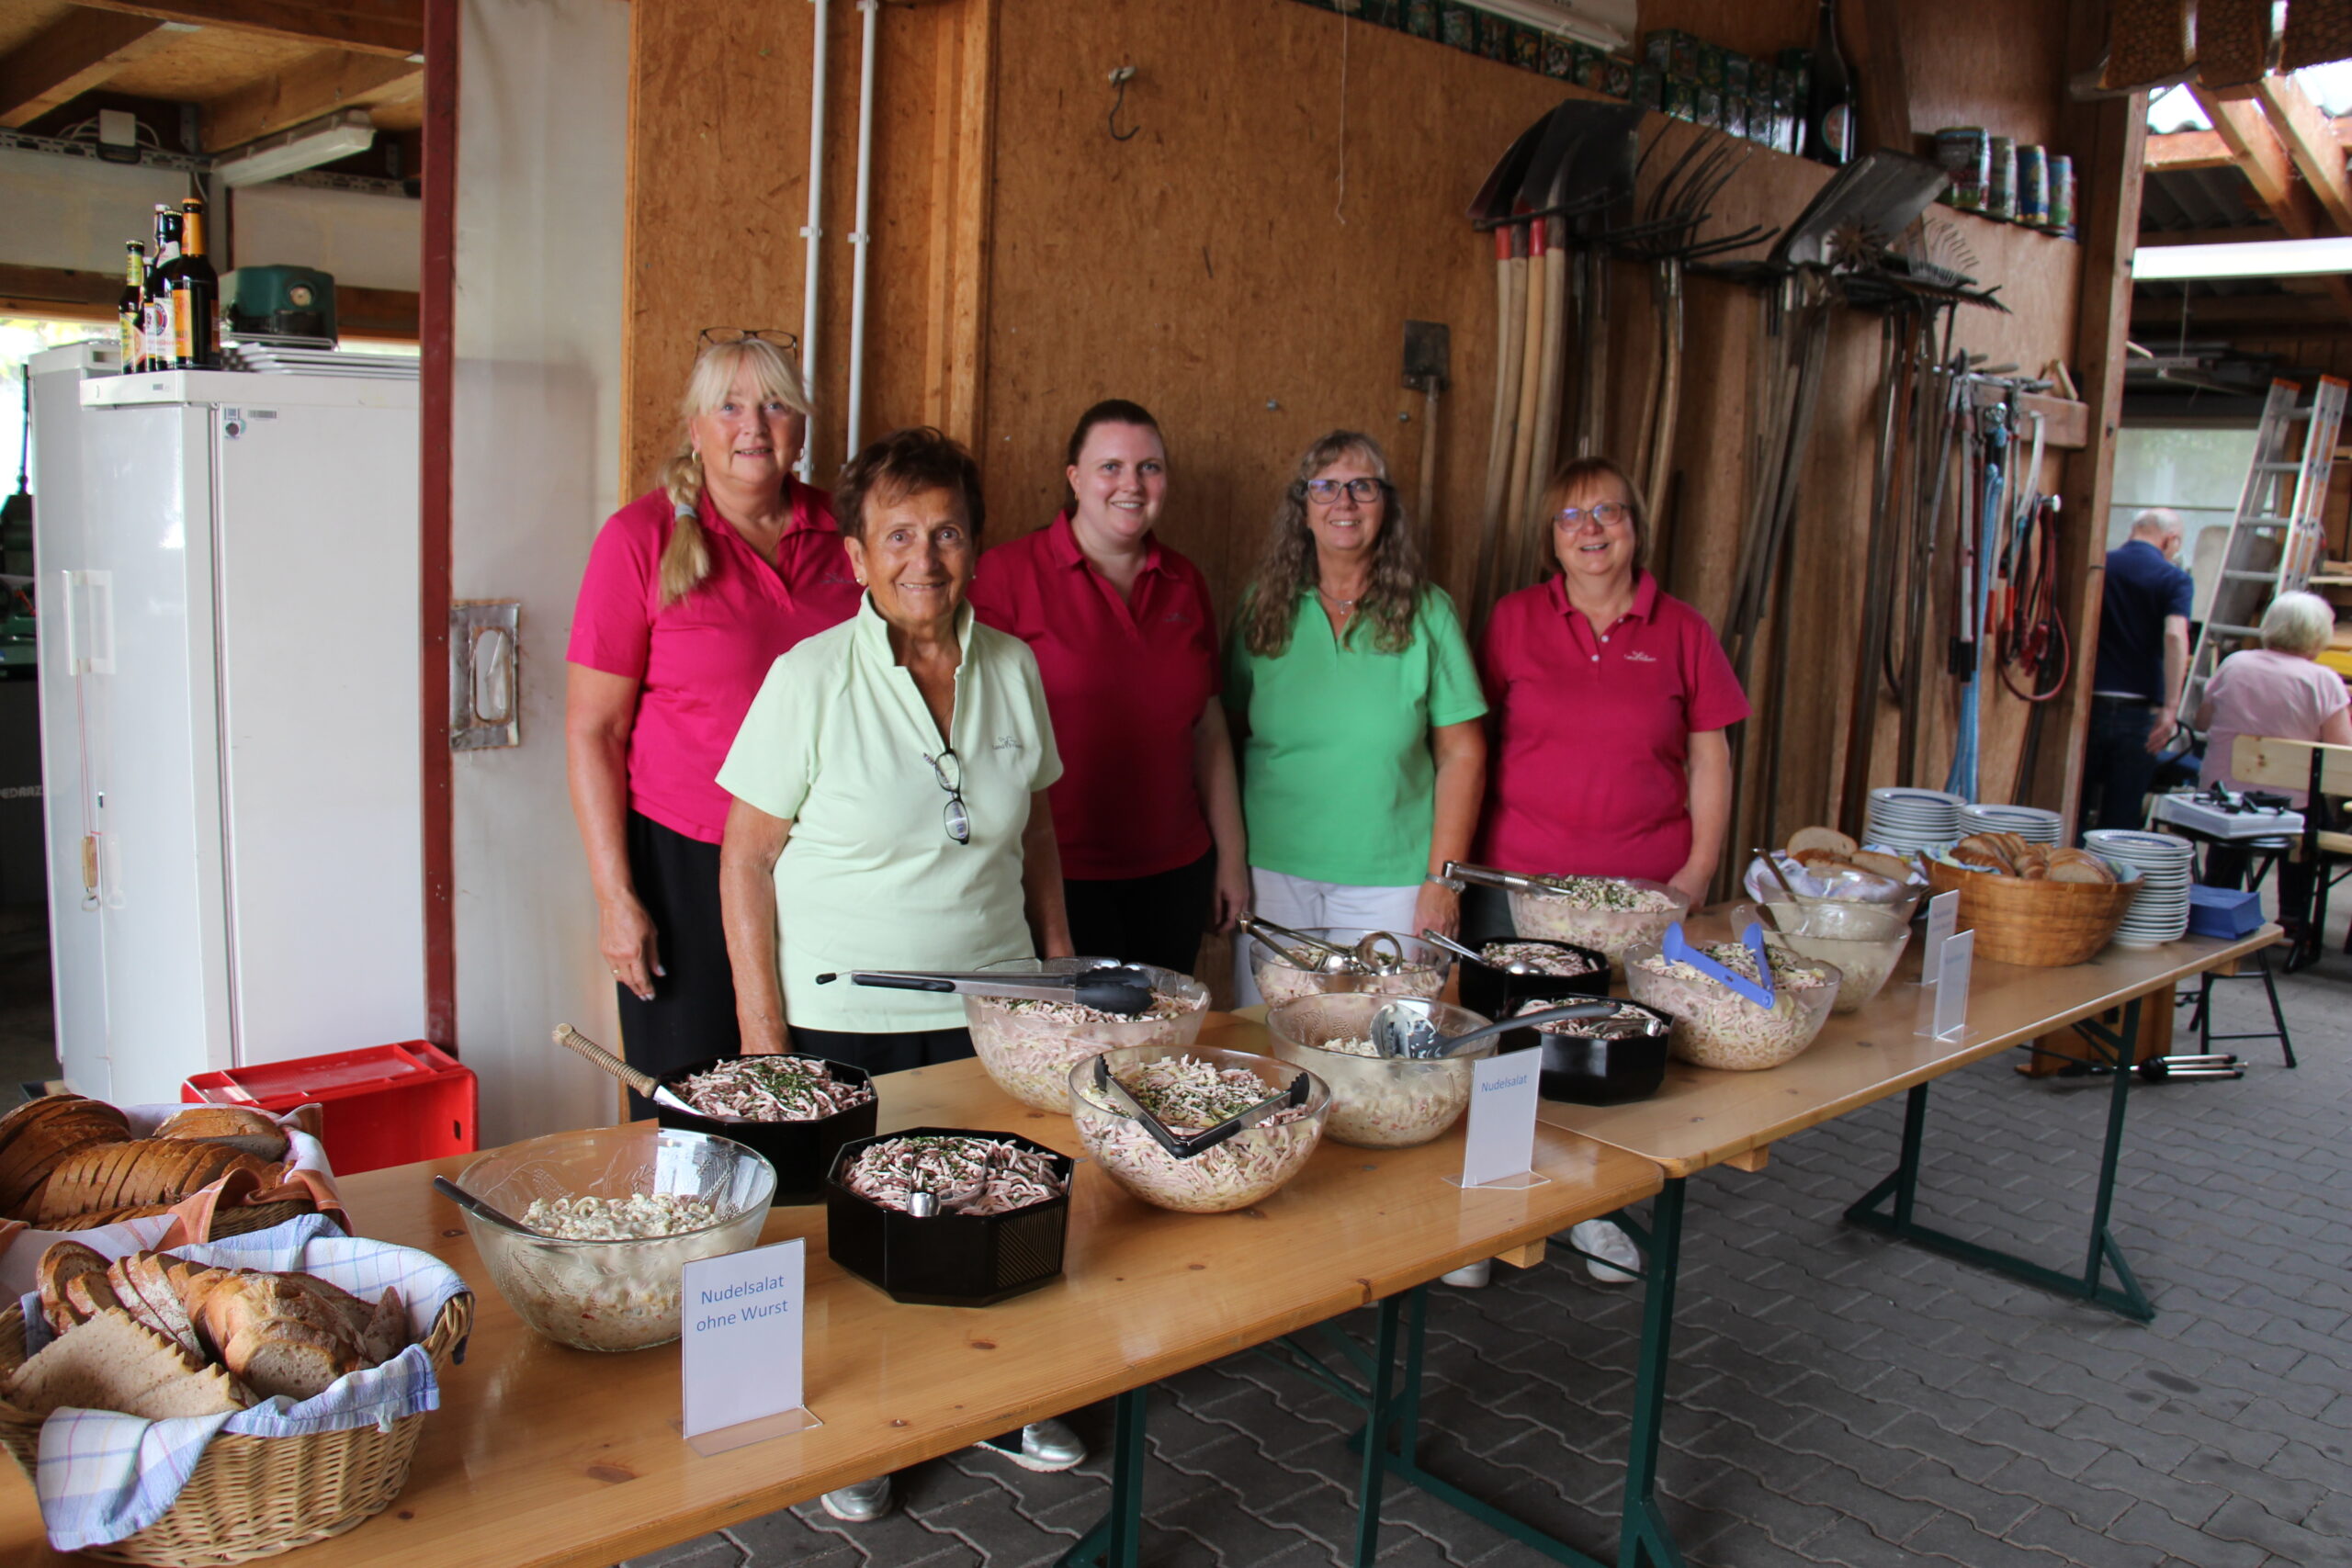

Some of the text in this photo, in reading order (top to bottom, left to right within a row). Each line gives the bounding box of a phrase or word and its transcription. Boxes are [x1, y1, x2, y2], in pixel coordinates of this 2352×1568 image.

[1481, 1074, 1528, 1092] Nudelsalat
[701, 1275, 784, 1304] Nudelsalat
[696, 1300, 788, 1332] ohne Wurst
